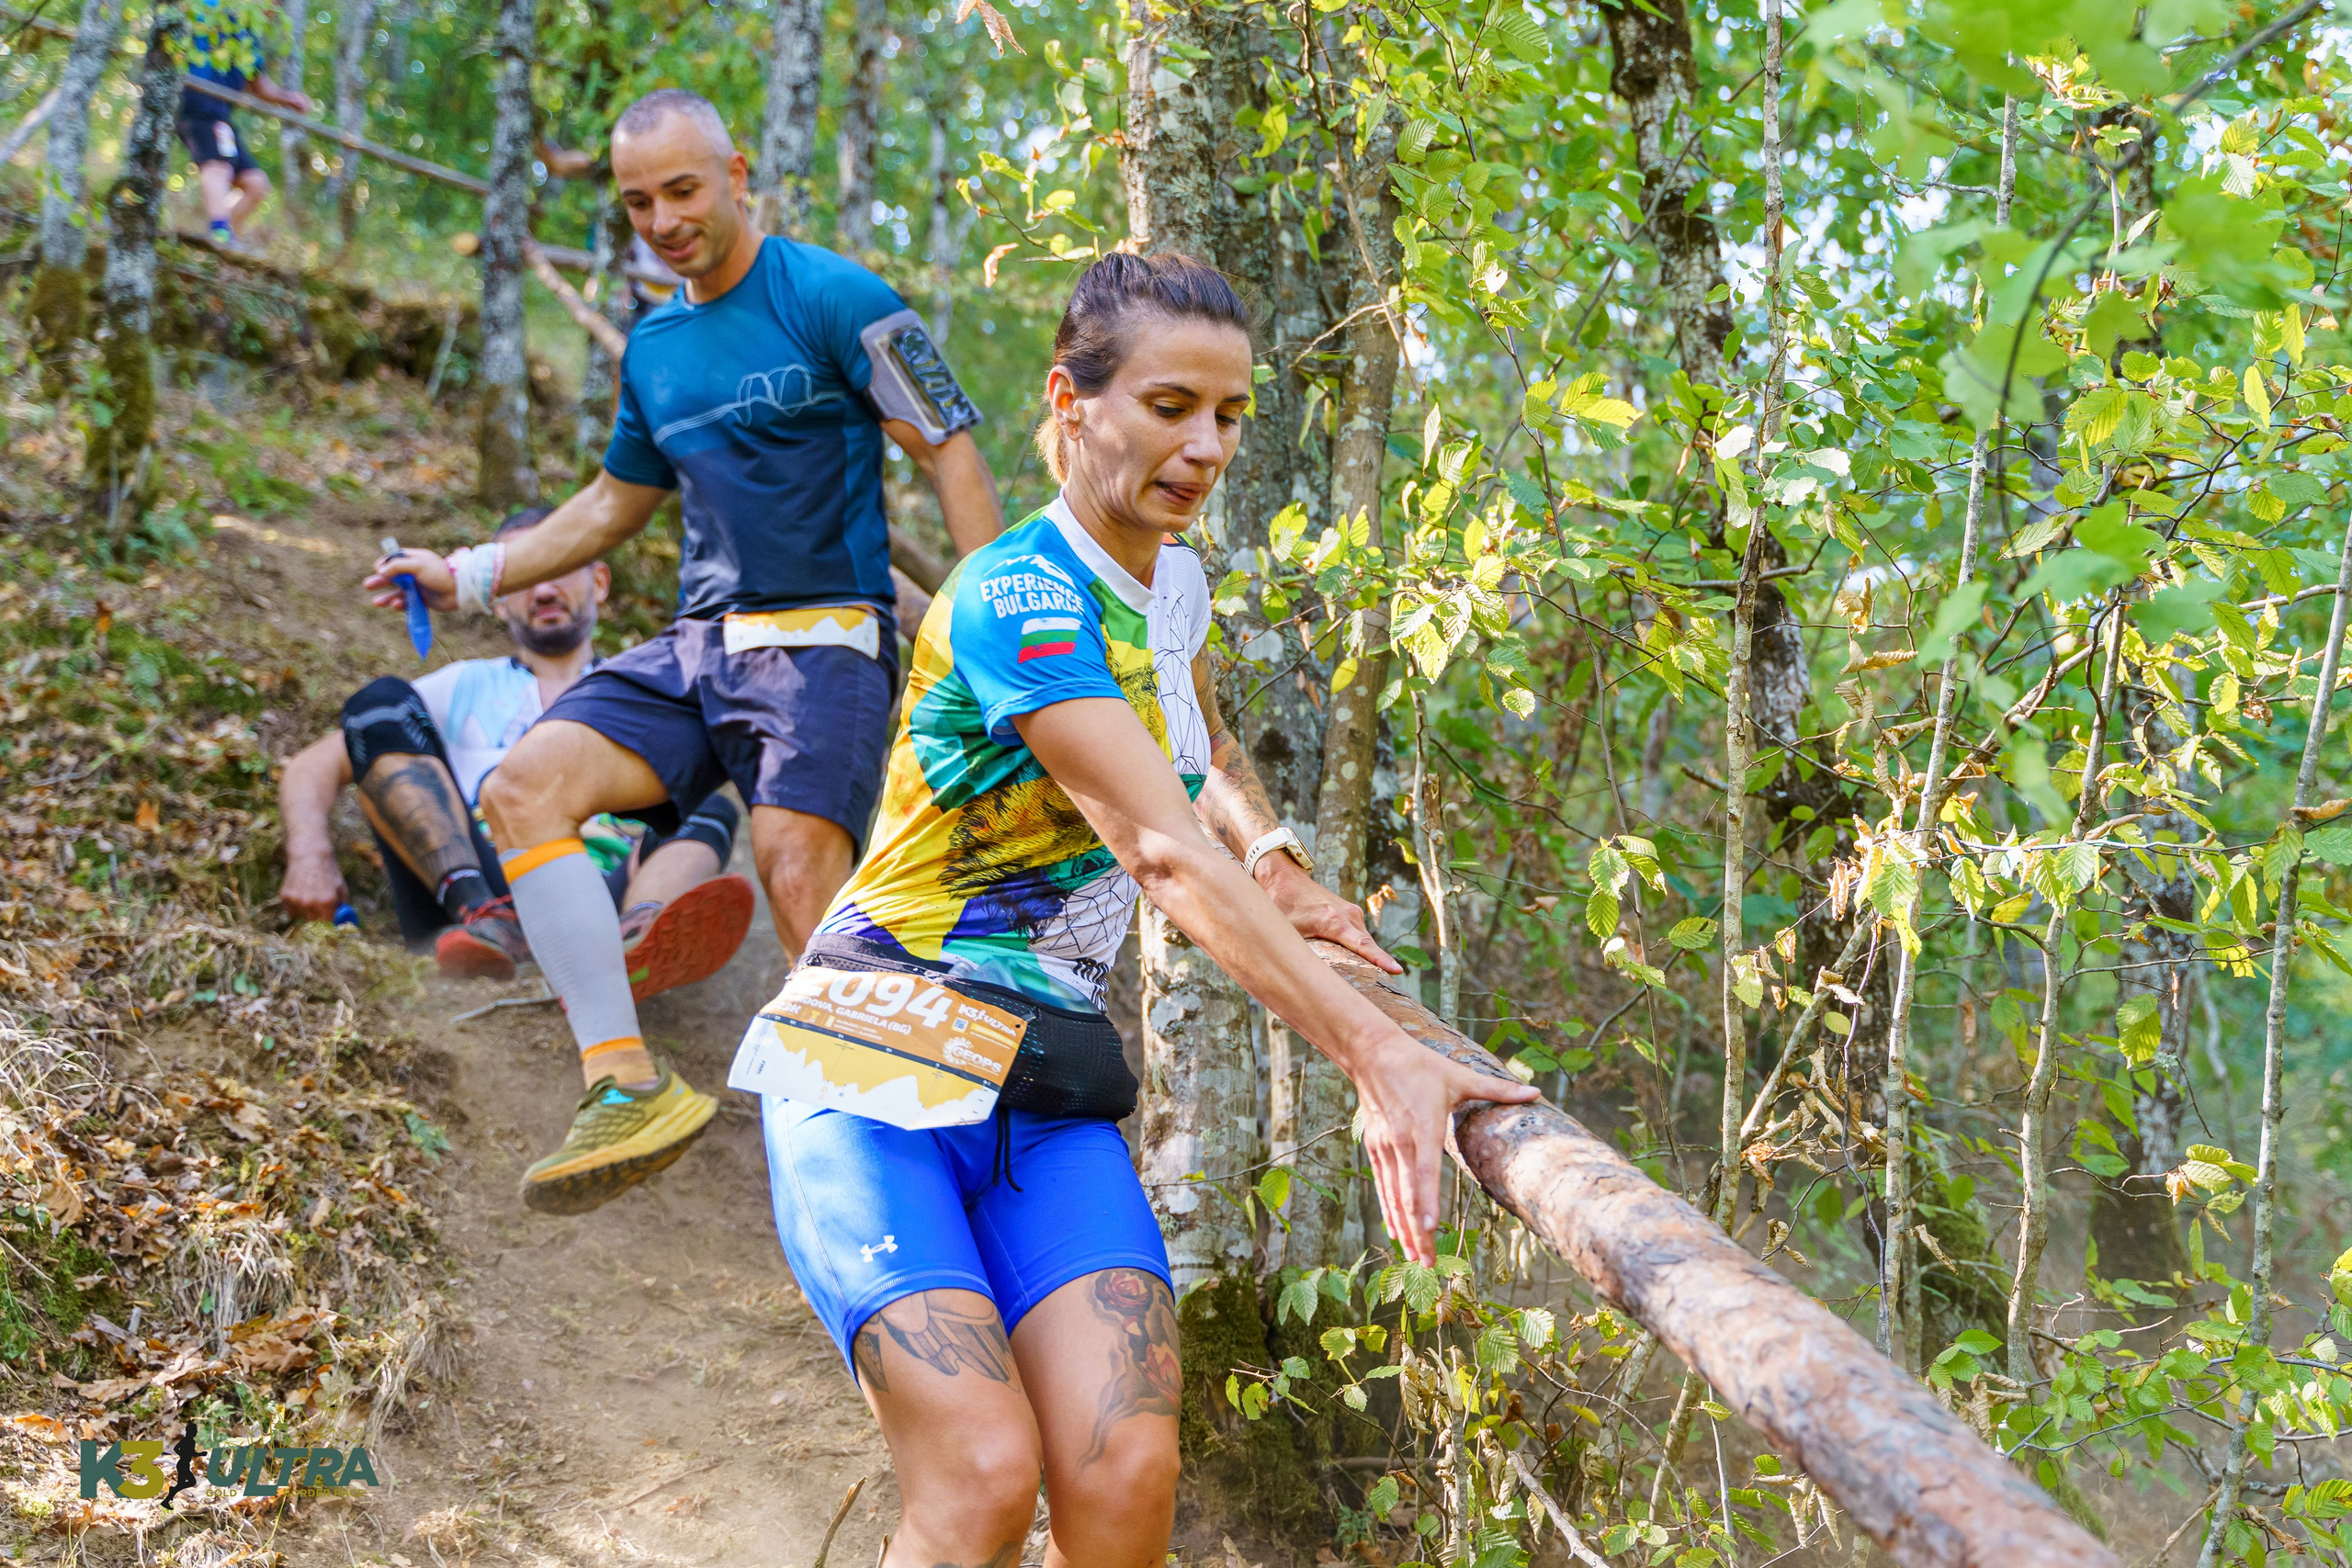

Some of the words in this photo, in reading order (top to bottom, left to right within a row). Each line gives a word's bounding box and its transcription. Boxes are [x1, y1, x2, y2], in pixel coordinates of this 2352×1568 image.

[979, 572, 1085, 612] EXPERIENCE
[835, 1006, 888, 1029] GABRIELA
[888, 1020, 912, 1036] (BG)
[983, 1011, 1016, 1037] ULTRA
[952, 1045, 1002, 1074] GEOPS
